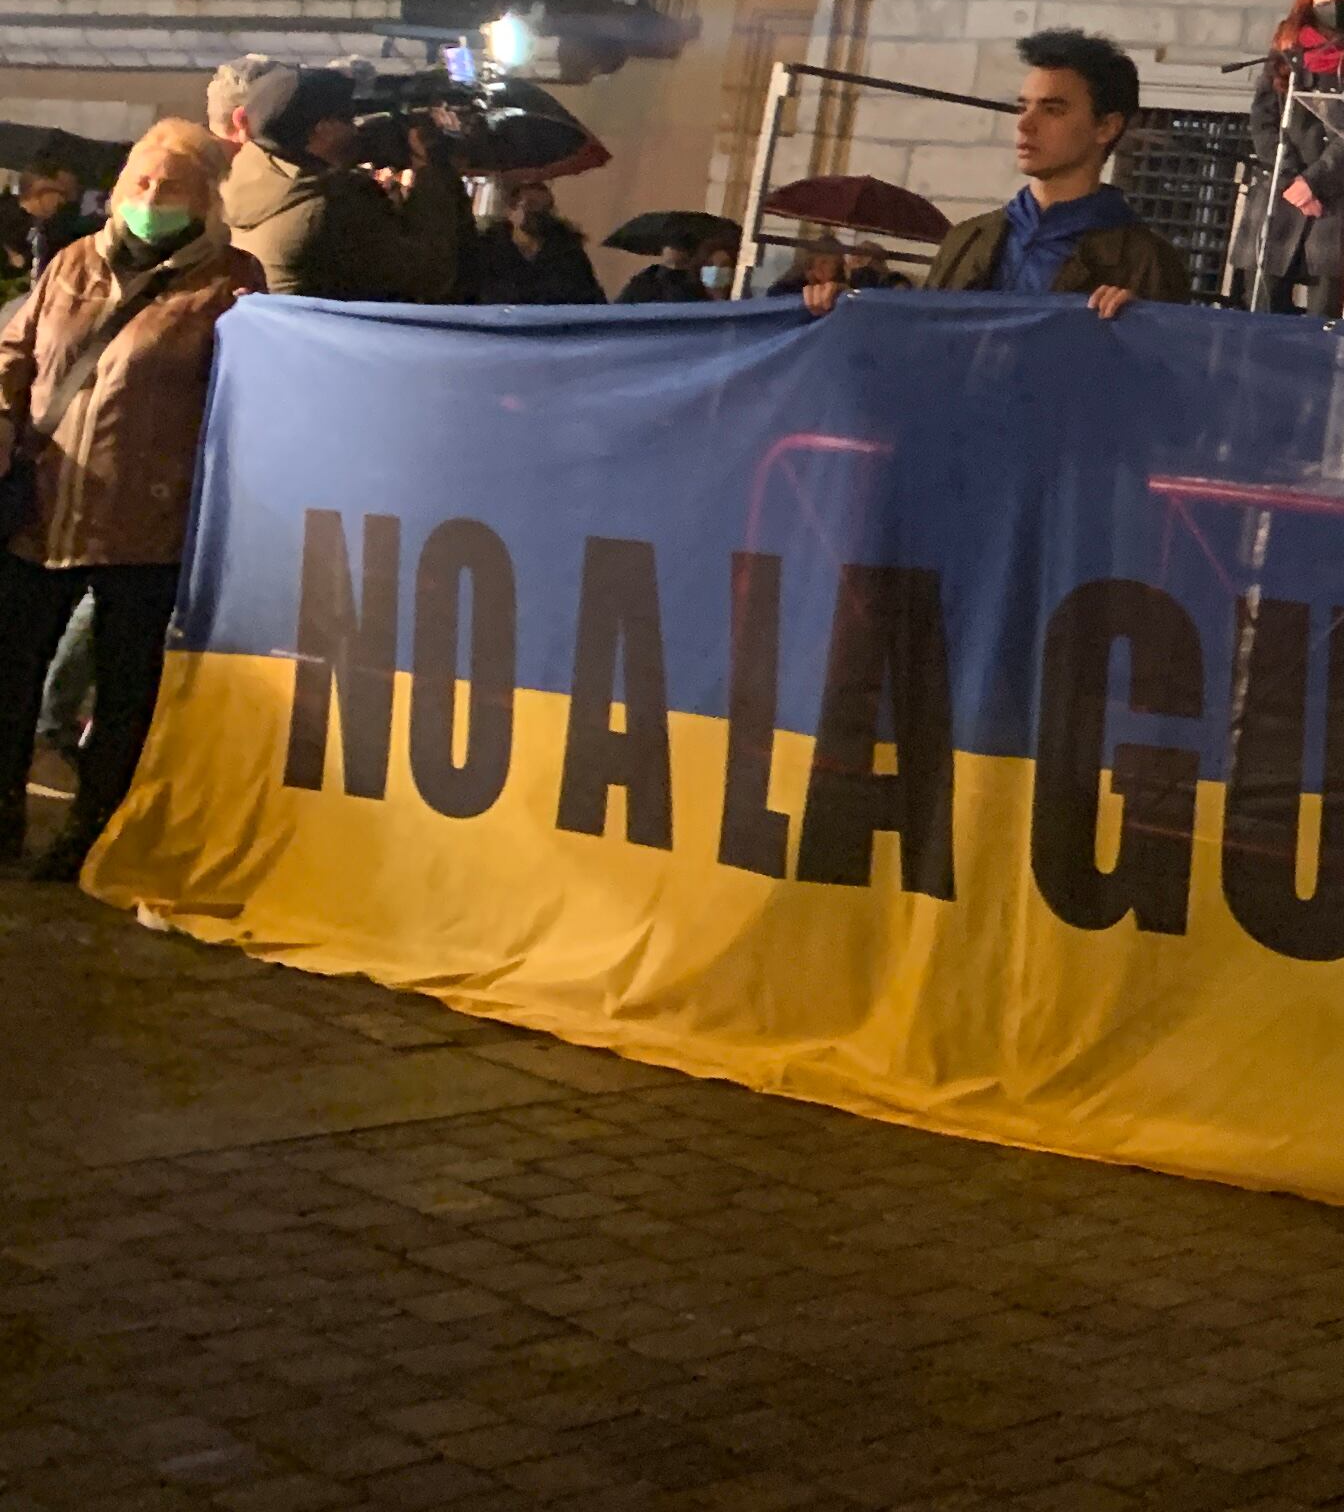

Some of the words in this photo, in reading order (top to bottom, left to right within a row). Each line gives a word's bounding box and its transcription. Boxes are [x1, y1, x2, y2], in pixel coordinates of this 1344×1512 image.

[283, 508, 517, 820] NO
[554, 535, 674, 852] A
[716, 550, 957, 902] LA
